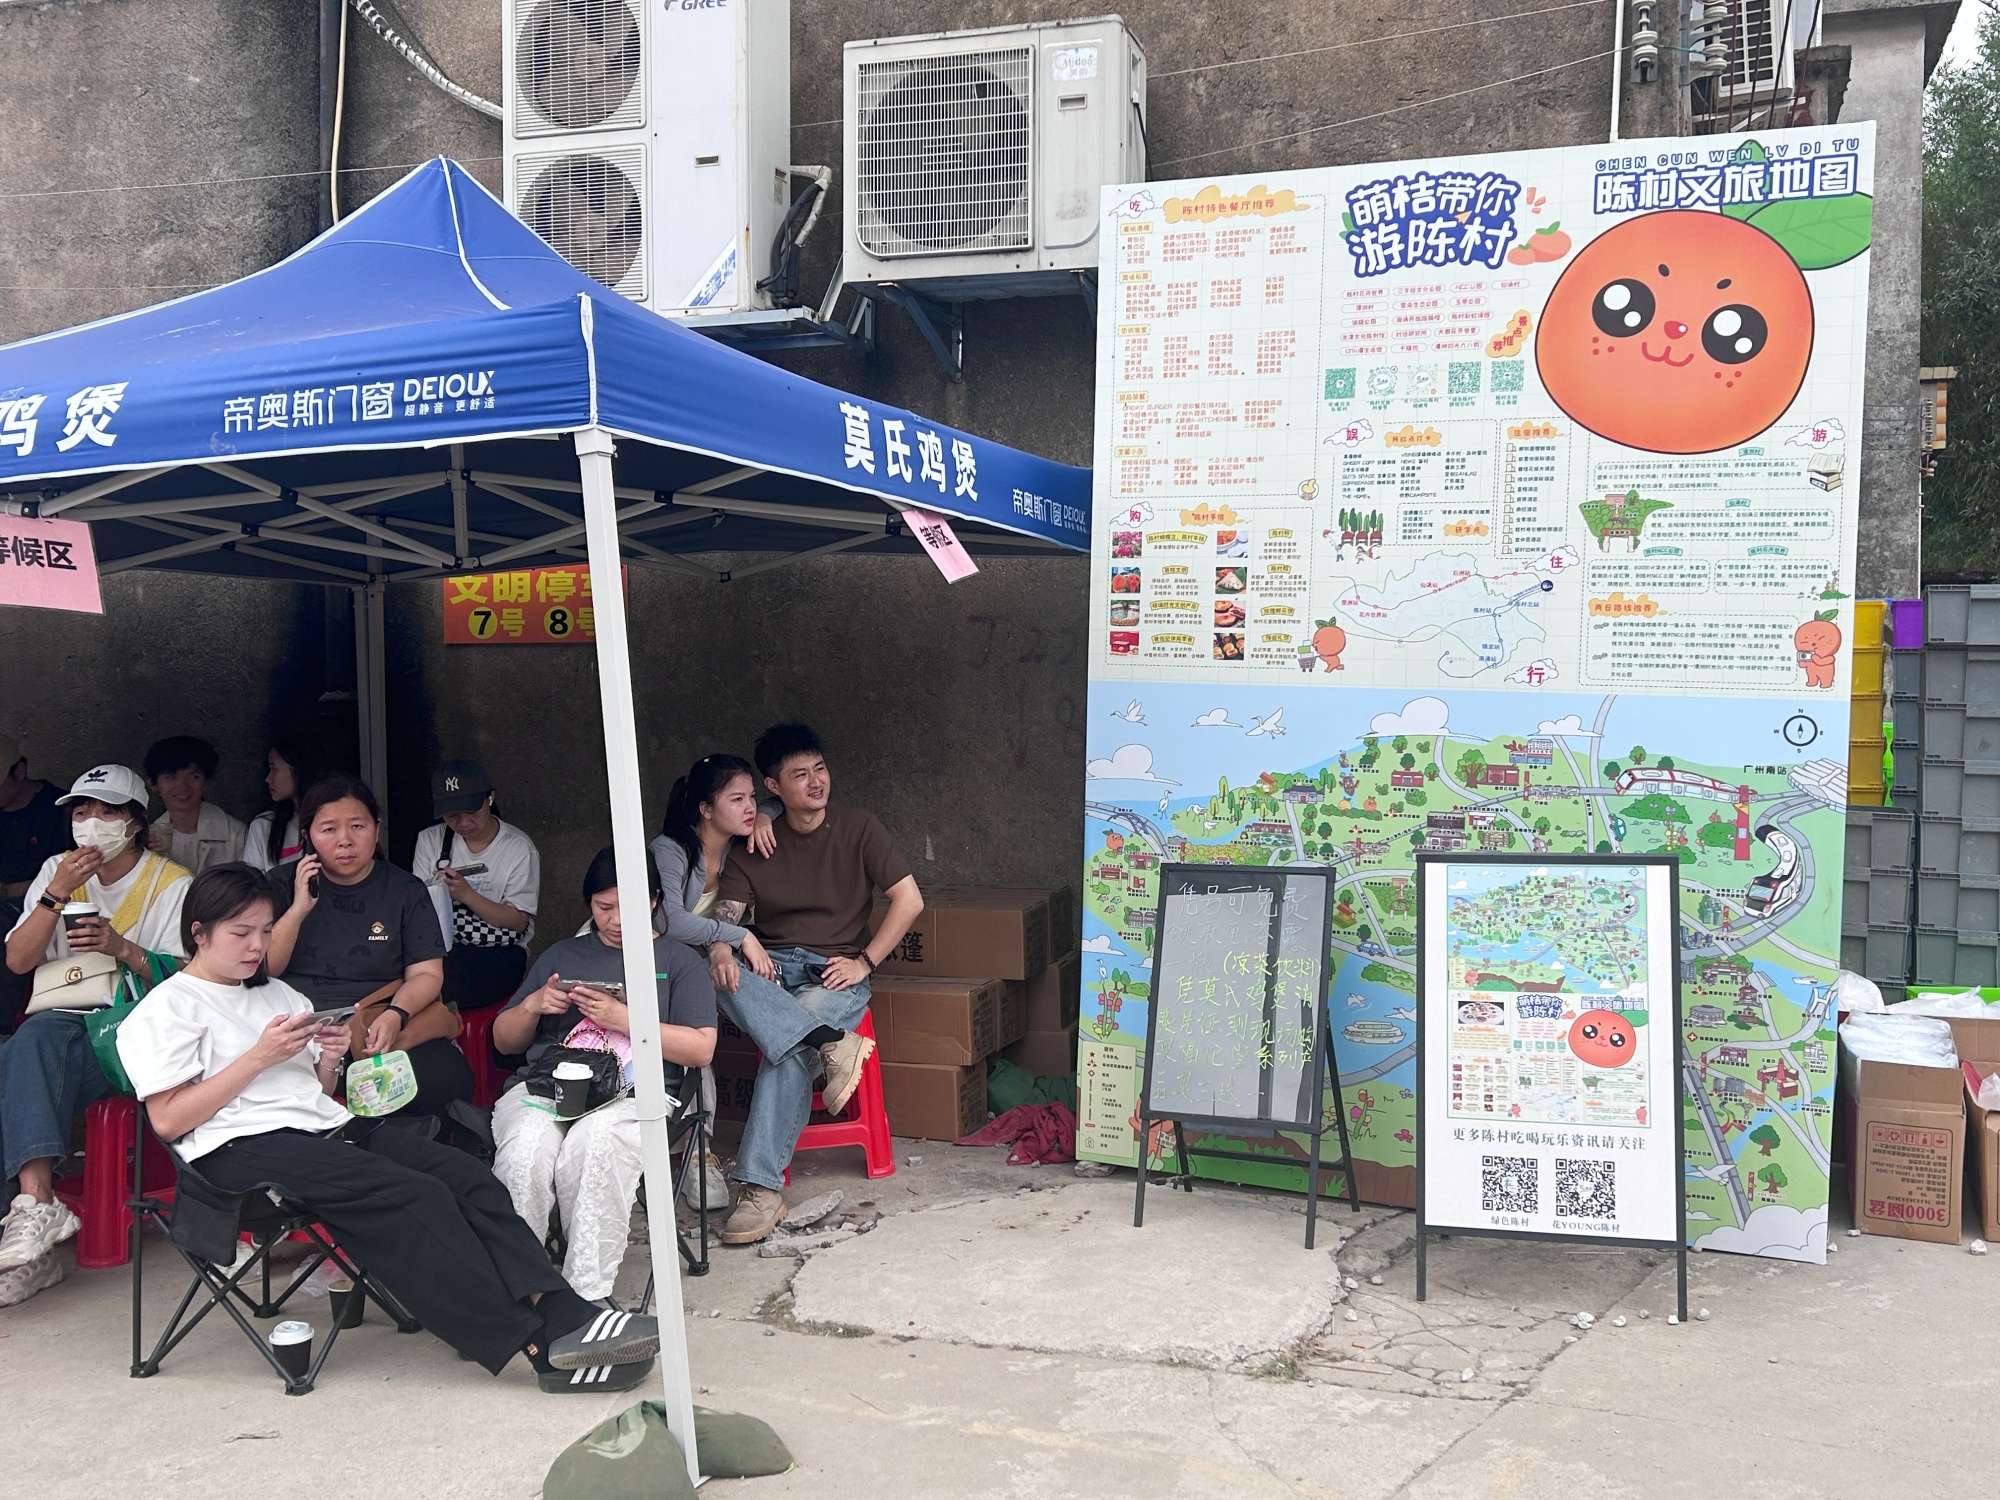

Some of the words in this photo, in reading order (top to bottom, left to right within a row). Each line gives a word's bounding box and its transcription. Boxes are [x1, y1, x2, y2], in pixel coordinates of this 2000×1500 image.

[1595, 156, 1647, 172] CHEN
[1657, 152, 1698, 166] CUN
[1709, 148, 1752, 163] WEN
[1764, 145, 1789, 158] LV
[1800, 142, 1821, 155] DI
[1833, 138, 1859, 151] TU
[1595, 154, 1857, 214] 陈村文旅地图
[1129, 200, 1141, 213] 吃
[1182, 199, 1275, 215] 陈村特色餐厅推荐
[1349, 174, 1517, 226] 萌桔带你
[1348, 217, 1515, 272] 游陈村
[223, 382, 395, 433] 帝奥斯门窗
[403, 370, 496, 403] DEIOUX
[404, 403, 444, 417] 超静音
[455, 397, 496, 413] 更舒适
[1346, 429, 1359, 441] 娱
[1514, 428, 1551, 437] 住宿推荐
[1812, 429, 1827, 441] 游
[839, 401, 979, 502] 莫氏鸡煲
[1012, 487, 1063, 527] 帝奥斯门窗
[1129, 510, 1141, 522] 购
[1550, 556, 1563, 569] 住
[1594, 604, 1652, 612] 两日路线推荐
[1526, 666, 1545, 684] 行
[1743, 764, 1787, 775] 广州南站
[1178, 881, 1309, 920] 凭号可免费
[1516, 994, 1564, 1009] 萌桔带你
[1519, 1005, 1563, 1020] 游陈村
[1452, 1126, 1647, 1151] 更多陈村吃喝玩乐资讯请关注
[1868, 1199, 1946, 1221] 3000圆盆
[1490, 1215, 1530, 1228] 绿色陈村
[1551, 1219, 1621, 1233] 花YOUNG陈村
